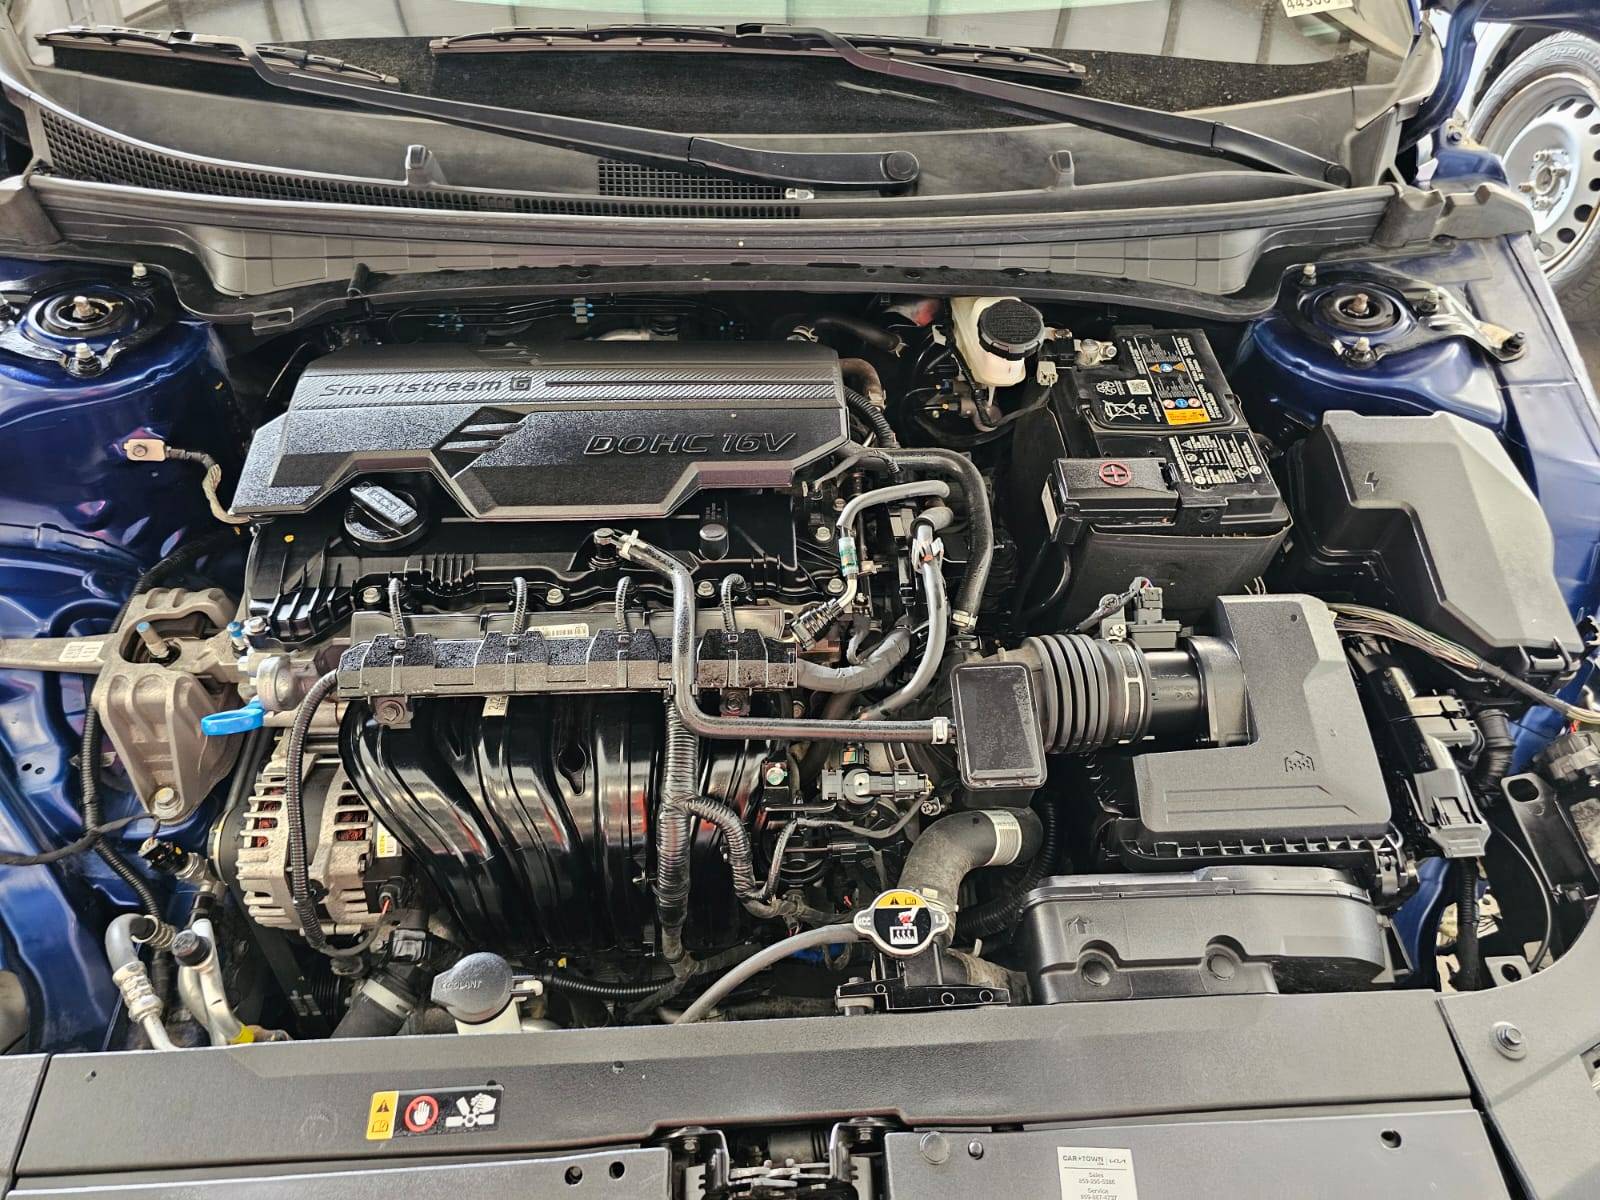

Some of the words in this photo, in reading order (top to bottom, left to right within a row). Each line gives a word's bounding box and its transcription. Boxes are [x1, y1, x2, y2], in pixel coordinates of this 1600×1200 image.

[319, 380, 503, 396] Smartstream
[584, 433, 714, 455] DOHC
[722, 432, 797, 453] 16V
[442, 980, 482, 991] COOLANT
